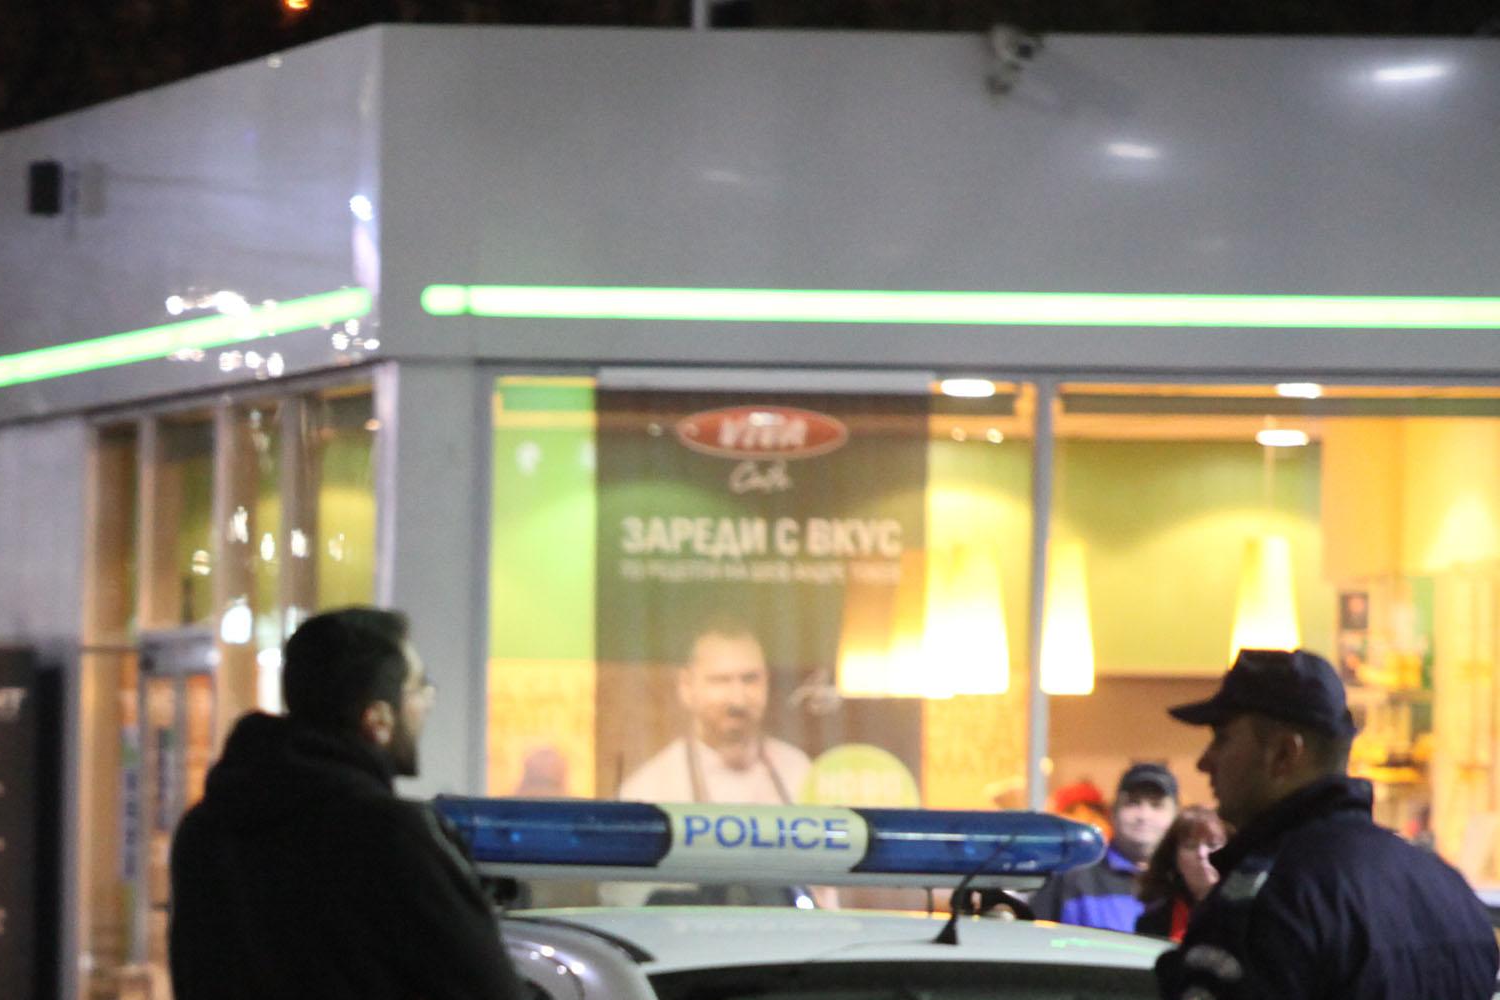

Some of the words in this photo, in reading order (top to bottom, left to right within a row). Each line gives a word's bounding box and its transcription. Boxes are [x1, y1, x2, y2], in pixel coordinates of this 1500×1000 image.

[622, 517, 767, 556] ЗАРЕДИ
[775, 519, 799, 554] С
[806, 518, 901, 555] ВКУС
[684, 814, 850, 851] POLICE
